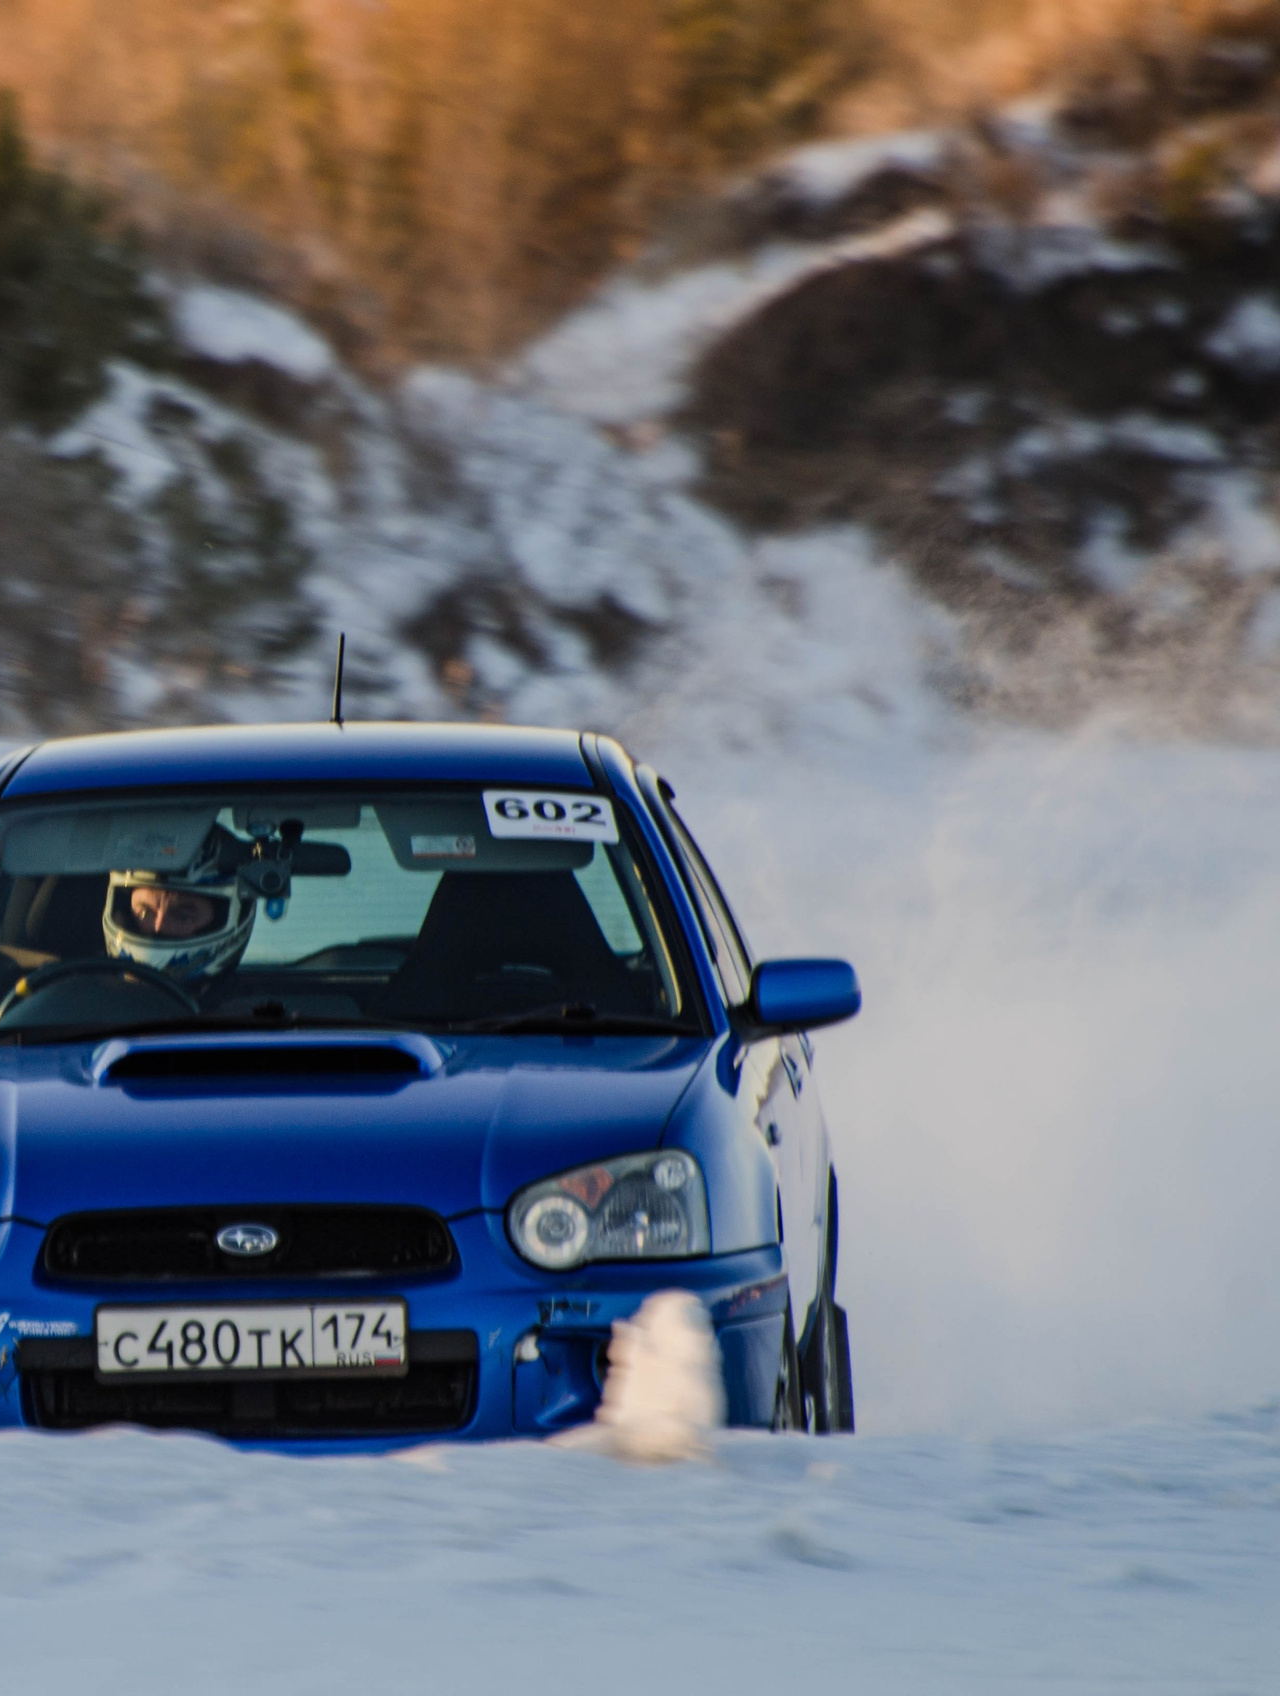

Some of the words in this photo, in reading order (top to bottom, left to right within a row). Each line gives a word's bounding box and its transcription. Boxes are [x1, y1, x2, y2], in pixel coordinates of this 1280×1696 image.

[494, 797, 607, 826] 602
[321, 1312, 393, 1350] 174
[336, 1352, 373, 1368] RUS
